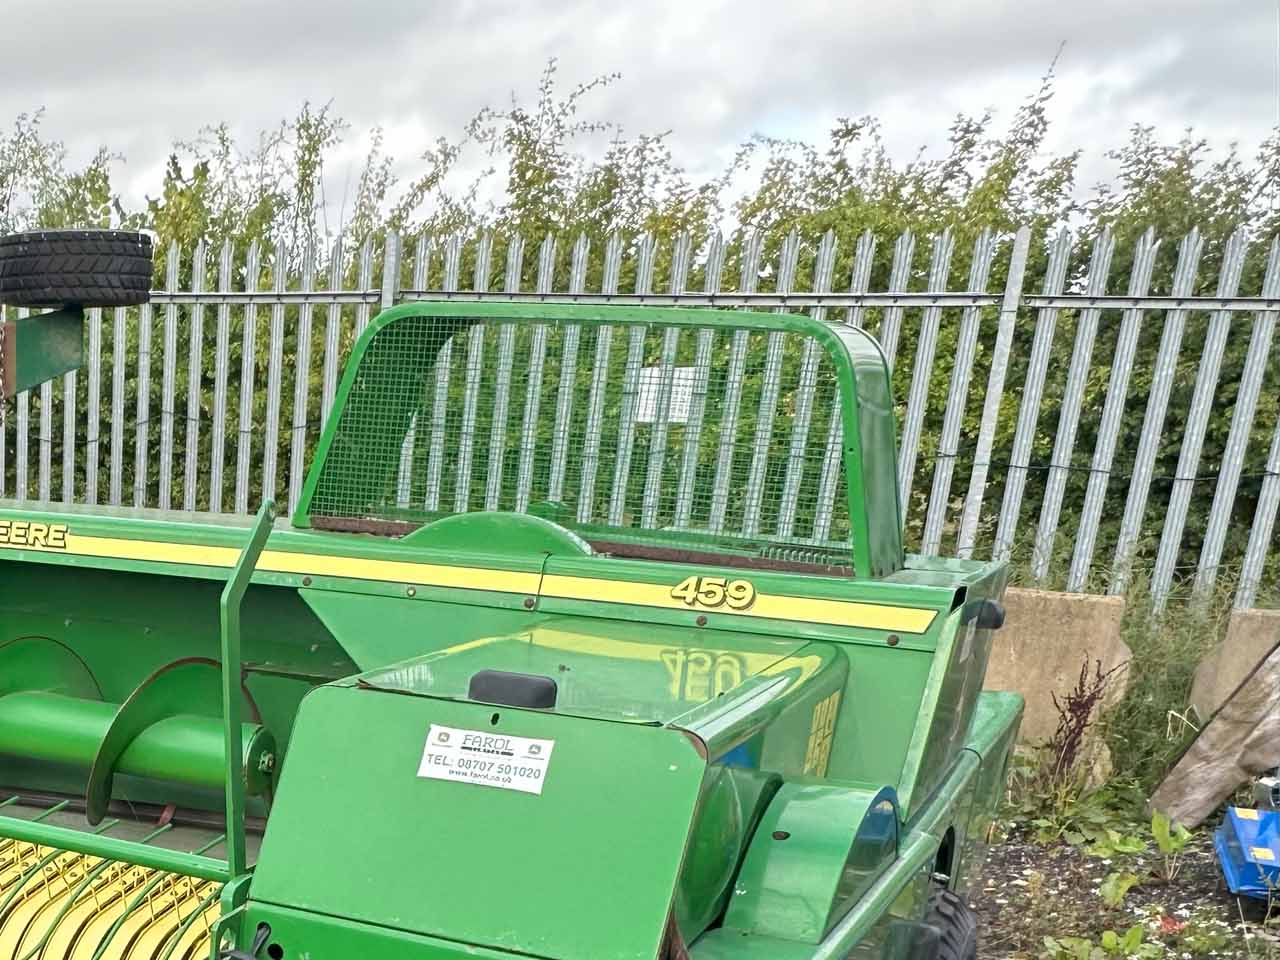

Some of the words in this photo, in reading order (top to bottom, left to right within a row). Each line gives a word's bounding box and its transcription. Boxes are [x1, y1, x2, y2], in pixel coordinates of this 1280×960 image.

[671, 576, 756, 611] 459
[461, 734, 515, 751] FAROL
[457, 758, 495, 772] 08707
[496, 763, 541, 779] 501020
